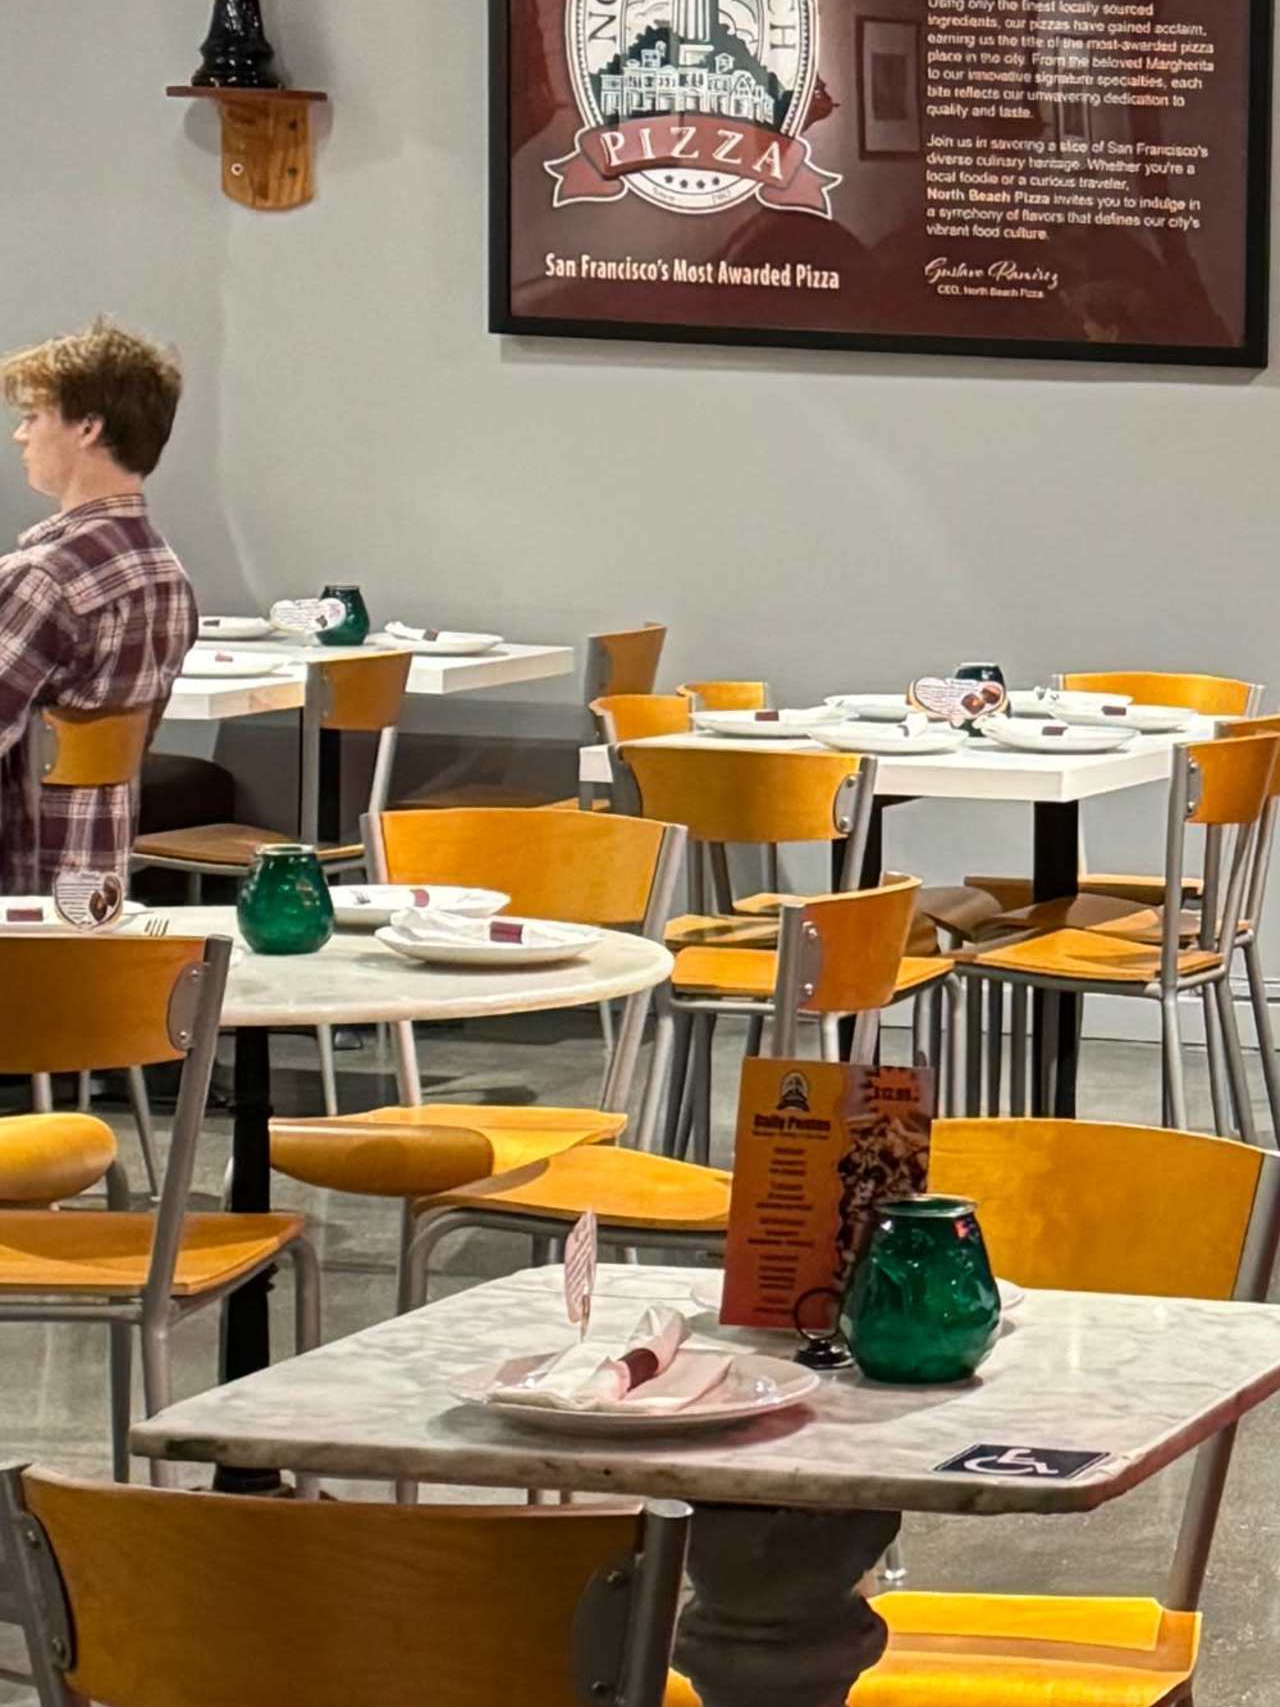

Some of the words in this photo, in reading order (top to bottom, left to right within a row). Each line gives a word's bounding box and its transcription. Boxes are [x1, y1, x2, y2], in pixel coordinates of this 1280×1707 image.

[1021, 0, 1056, 13] finest
[1058, 0, 1100, 17] locally
[1102, 2, 1154, 16] sourced
[1004, 19, 1027, 29] our
[1029, 17, 1071, 34] pizzas
[1073, 18, 1105, 32] have
[1107, 20, 1151, 37] gained
[927, 31, 976, 48] earning
[978, 35, 995, 46] us
[997, 33, 1019, 47] the
[1021, 34, 1045, 48] title
[1047, 35, 1061, 48] of
[1060, 36, 1085, 49] the
[1085, 37, 1177, 53] most-awarded
[1180, 40, 1215, 57] pizza
[927, 49, 963, 66] place
[965, 50, 977, 63] in
[980, 51, 1001, 64] the
[1032, 53, 1067, 67] From
[1066, 54, 1090, 67] the
[1092, 55, 1143, 69] beloved
[1146, 57, 1215, 75] Margherita
[927, 67, 941, 80] to
[942, 70, 964, 80] our
[968, 68, 1032, 83] innovative
[1034, 71, 1095, 88] signature
[1170, 76, 1203, 89] each
[927, 85, 951, 98] bite
[954, 86, 1001, 100] reflects
[1003, 90, 1025, 101] our
[1026, 88, 1101, 107] unwavering
[1103, 91, 1169, 106] dedication
[1172, 94, 1185, 107] to
[926, 102, 969, 119] quality
[971, 104, 996, 117] and
[600, 126, 785, 182] PIZZA
[926, 134, 954, 148] Join
[956, 138, 973, 149] us
[975, 136, 988, 149] in
[990, 137, 1045, 154] savoring
[1048, 142, 1057, 152] a
[1059, 139, 1090, 153] slice
[1091, 140, 1105, 153] of
[1107, 141, 1134, 155] San
[1136, 142, 1209, 157] Francisco's
[926, 152, 974, 166] diverse
[976, 154, 1026, 171] culinary
[1086, 158, 1141, 172] Whether
[1144, 160, 1184, 177] you're
[1186, 164, 1195, 174] a
[926, 169, 957, 183] local
[959, 171, 999, 185] foodie
[1000, 175, 1015, 185] or
[1018, 176, 1027, 186] a
[1029, 173, 1077, 188] curious
[927, 187, 965, 201] North
[968, 189, 1011, 203] Beach
[1014, 190, 1051, 204] Pizza
[1053, 192, 1094, 206] invites
[1097, 196, 1121, 210] you
[1124, 195, 1137, 208] to
[1139, 195, 1186, 212] indulge
[1189, 197, 1201, 210] in
[926, 208, 936, 218] a
[938, 206, 1004, 224] symphony
[1006, 208, 1020, 221] of
[1021, 209, 1065, 223] flavors
[1067, 210, 1092, 224] that
[1094, 211, 1141, 226] defines
[1143, 216, 1166, 227] our
[1168, 214, 1201, 231] city's
[926, 222, 970, 236] vibrant
[972, 224, 1001, 238] food
[545, 252, 577, 278] San
[581, 254, 669, 281] Francisco's
[673, 258, 713, 284] Most
[718, 260, 791, 287] Awarded
[796, 264, 840, 289] Pizza
